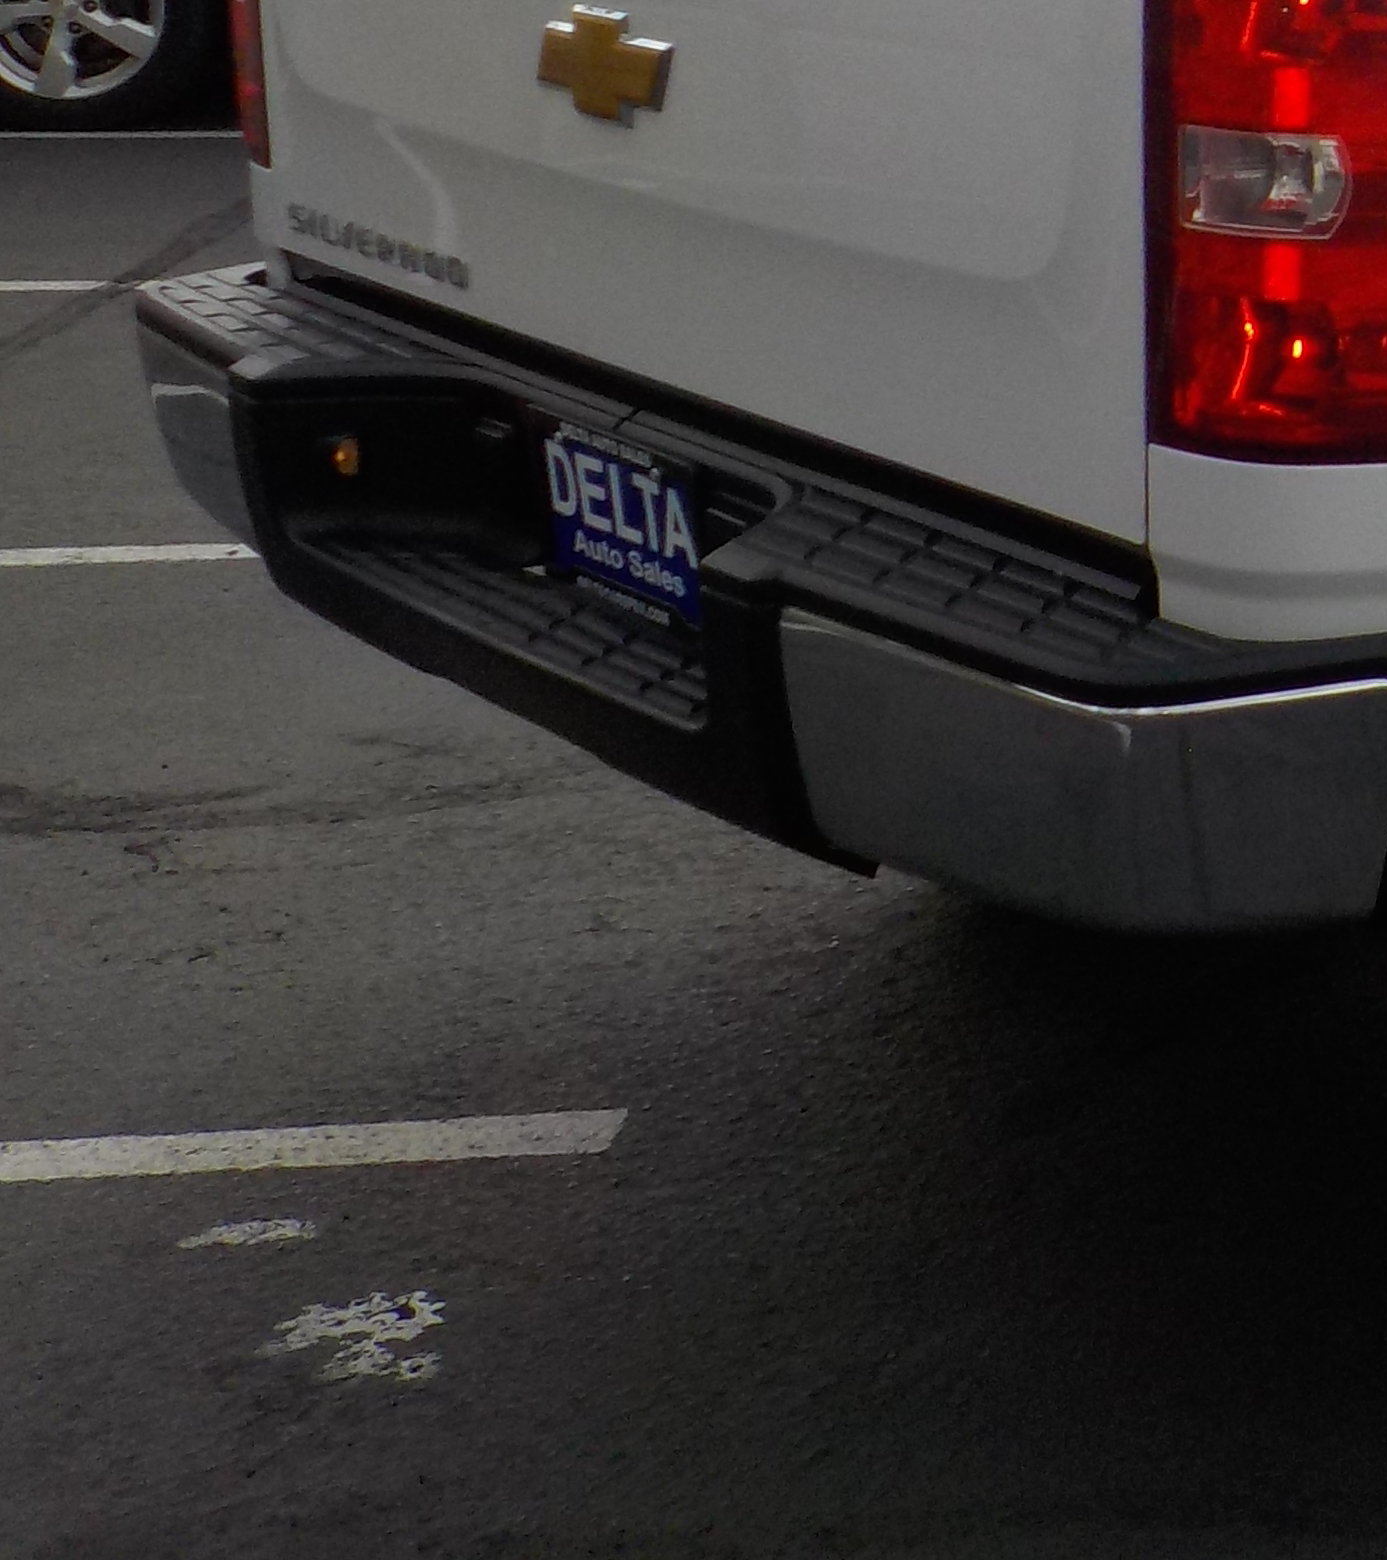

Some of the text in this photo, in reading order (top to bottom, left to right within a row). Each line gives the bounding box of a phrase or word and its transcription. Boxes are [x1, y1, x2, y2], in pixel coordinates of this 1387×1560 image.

[543, 437, 699, 570] DELTA
[573, 528, 687, 598] Auto Sales
